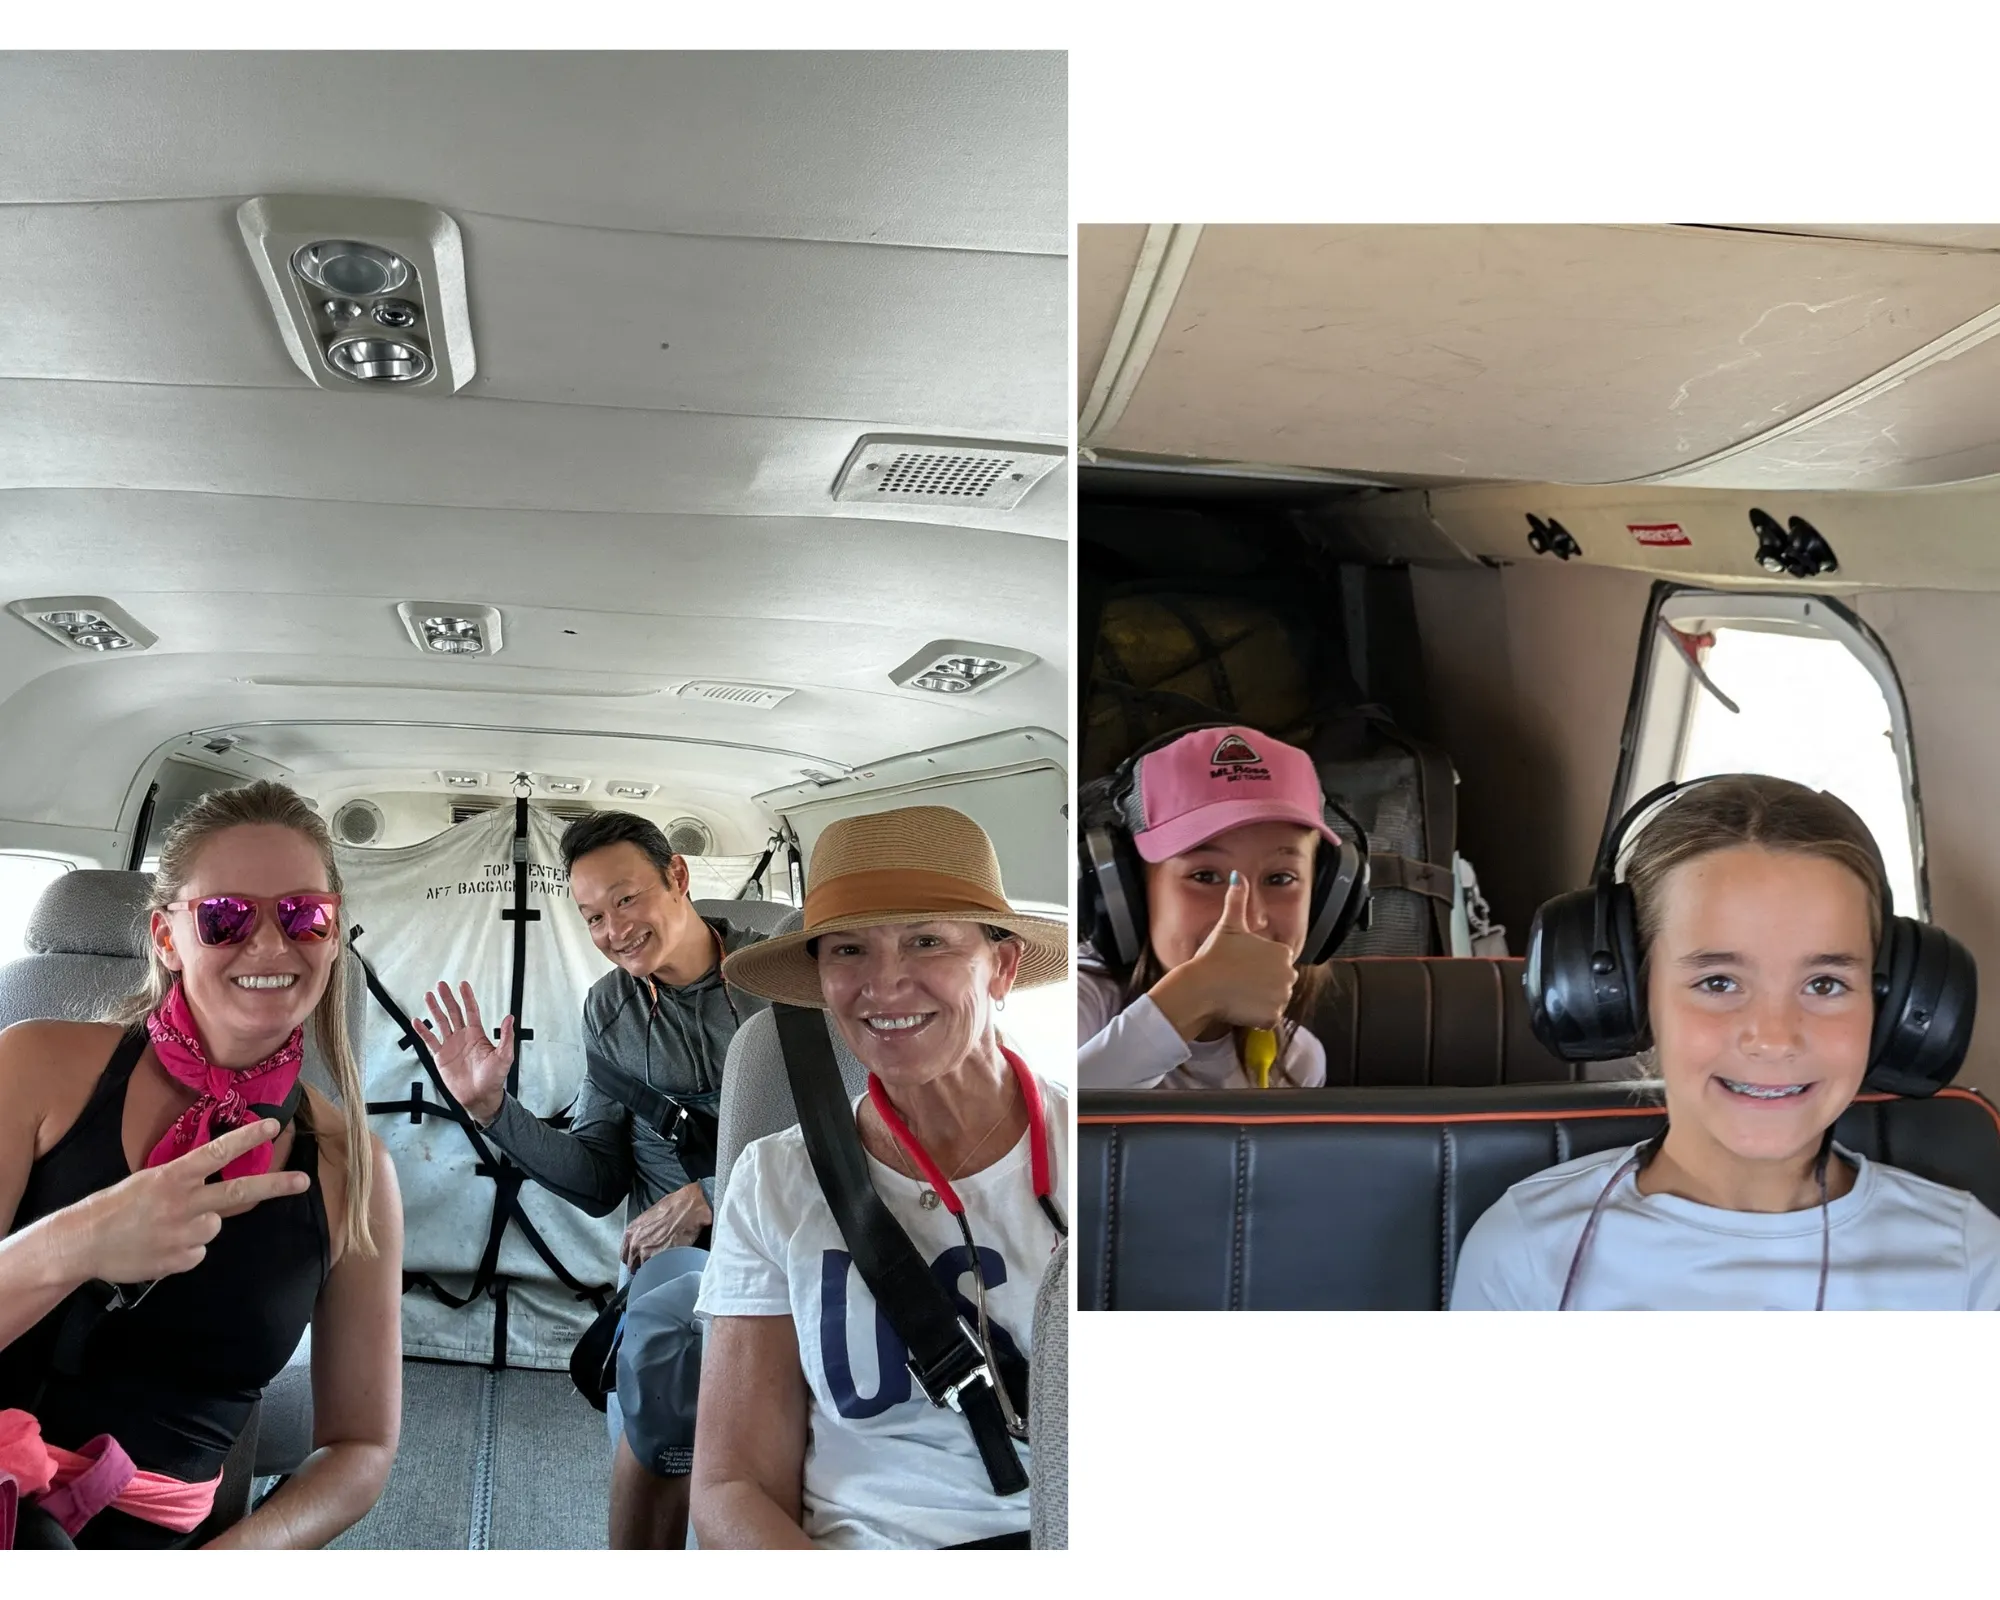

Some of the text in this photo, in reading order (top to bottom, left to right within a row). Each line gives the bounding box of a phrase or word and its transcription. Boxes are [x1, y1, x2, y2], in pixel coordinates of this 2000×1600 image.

[1233, 764, 1269, 774] Rose
[483, 863, 570, 883] TOP ENTER
[426, 885, 452, 900] AFT
